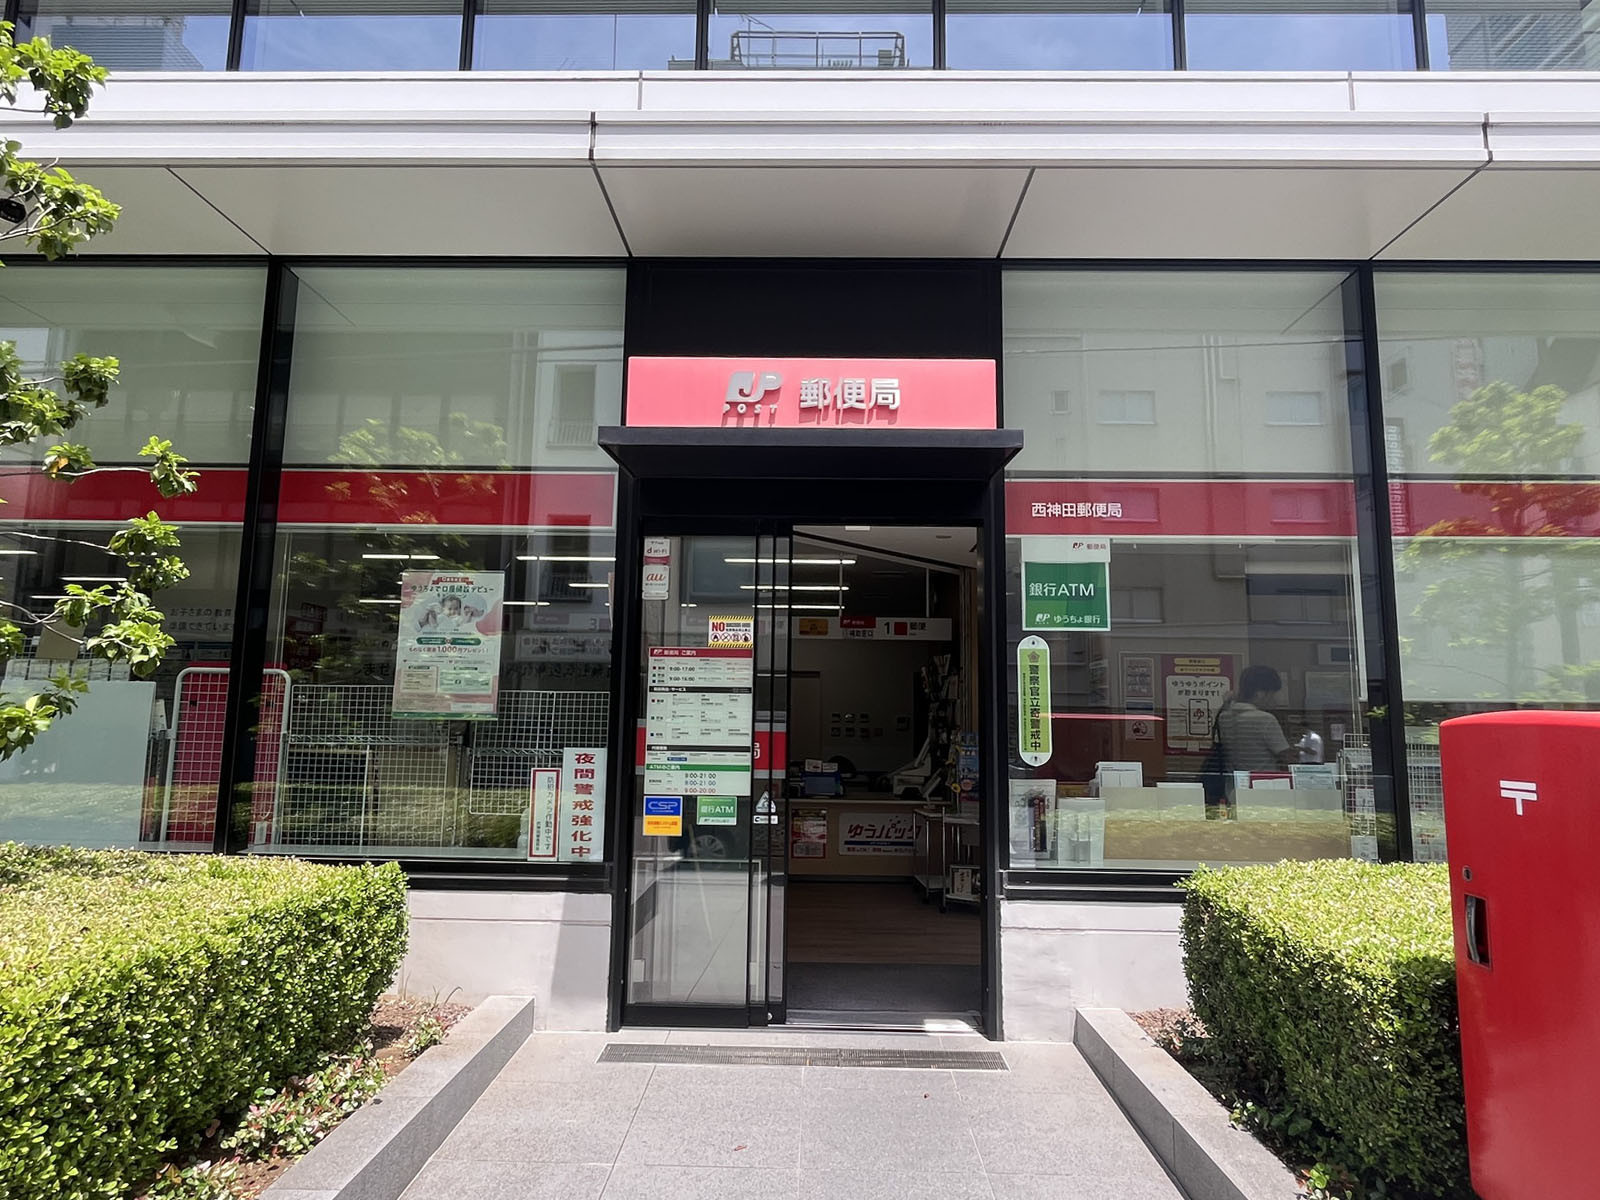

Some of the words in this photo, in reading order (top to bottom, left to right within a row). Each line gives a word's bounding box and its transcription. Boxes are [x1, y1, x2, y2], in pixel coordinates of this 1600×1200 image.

[799, 377, 901, 410] 郵便局
[723, 403, 778, 414] POST
[1031, 502, 1122, 518] 西神田郵便局
[647, 573, 665, 581] au
[1029, 582, 1094, 597] 銀行ATM
[1053, 614, 1101, 624] ゆうちょ銀行
[712, 622, 725, 632] NO
[884, 621, 890, 635] 1
[570, 752, 596, 858] 夜間警戒強化中
[648, 801, 678, 809] CSP
